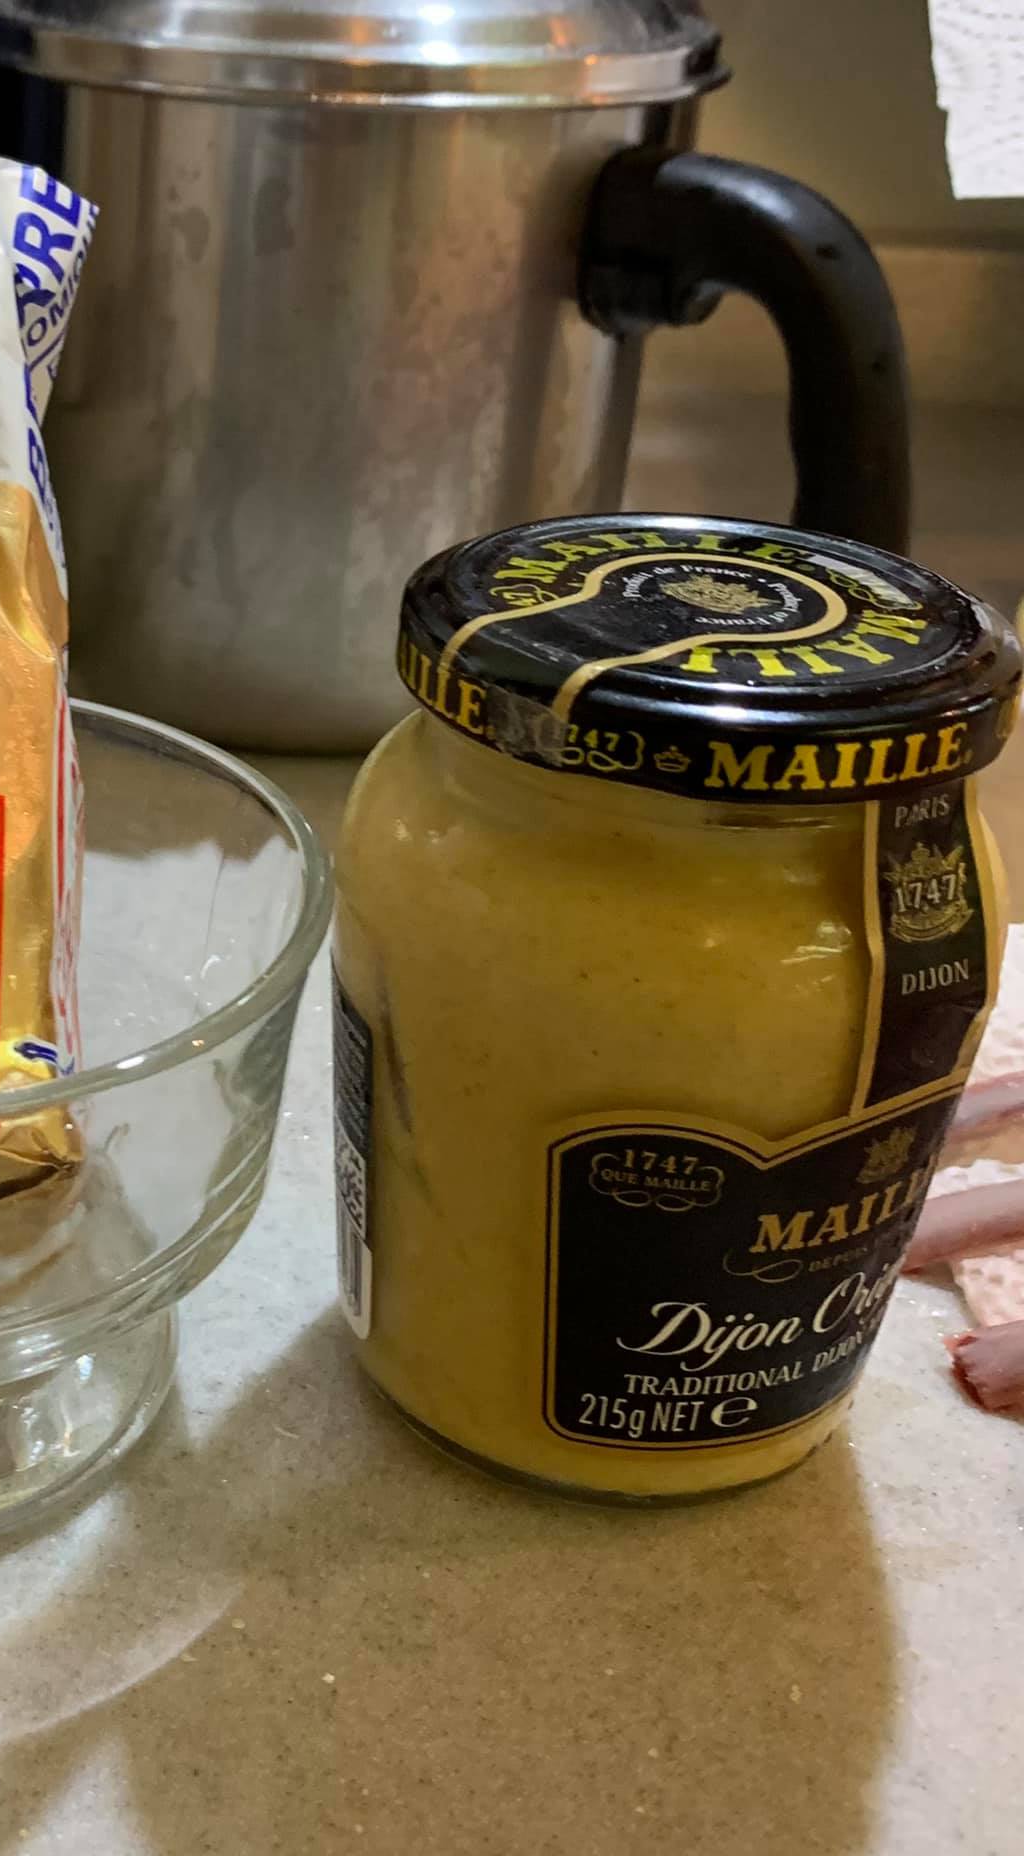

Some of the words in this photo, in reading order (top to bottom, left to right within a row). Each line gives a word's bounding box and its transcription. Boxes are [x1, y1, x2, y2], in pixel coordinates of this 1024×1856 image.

[704, 722, 969, 792] MAILLE
[894, 794, 950, 828] PARIS
[895, 873, 957, 913] 1747
[901, 959, 969, 996] DIJON
[624, 1149, 699, 1175] 1747
[600, 1168, 640, 1185] QUE
[644, 1175, 711, 1192] MAILLE
[616, 1302, 803, 1373] Dijon
[624, 1361, 804, 1396] TRADITIONAL
[650, 1401, 705, 1432] NET
